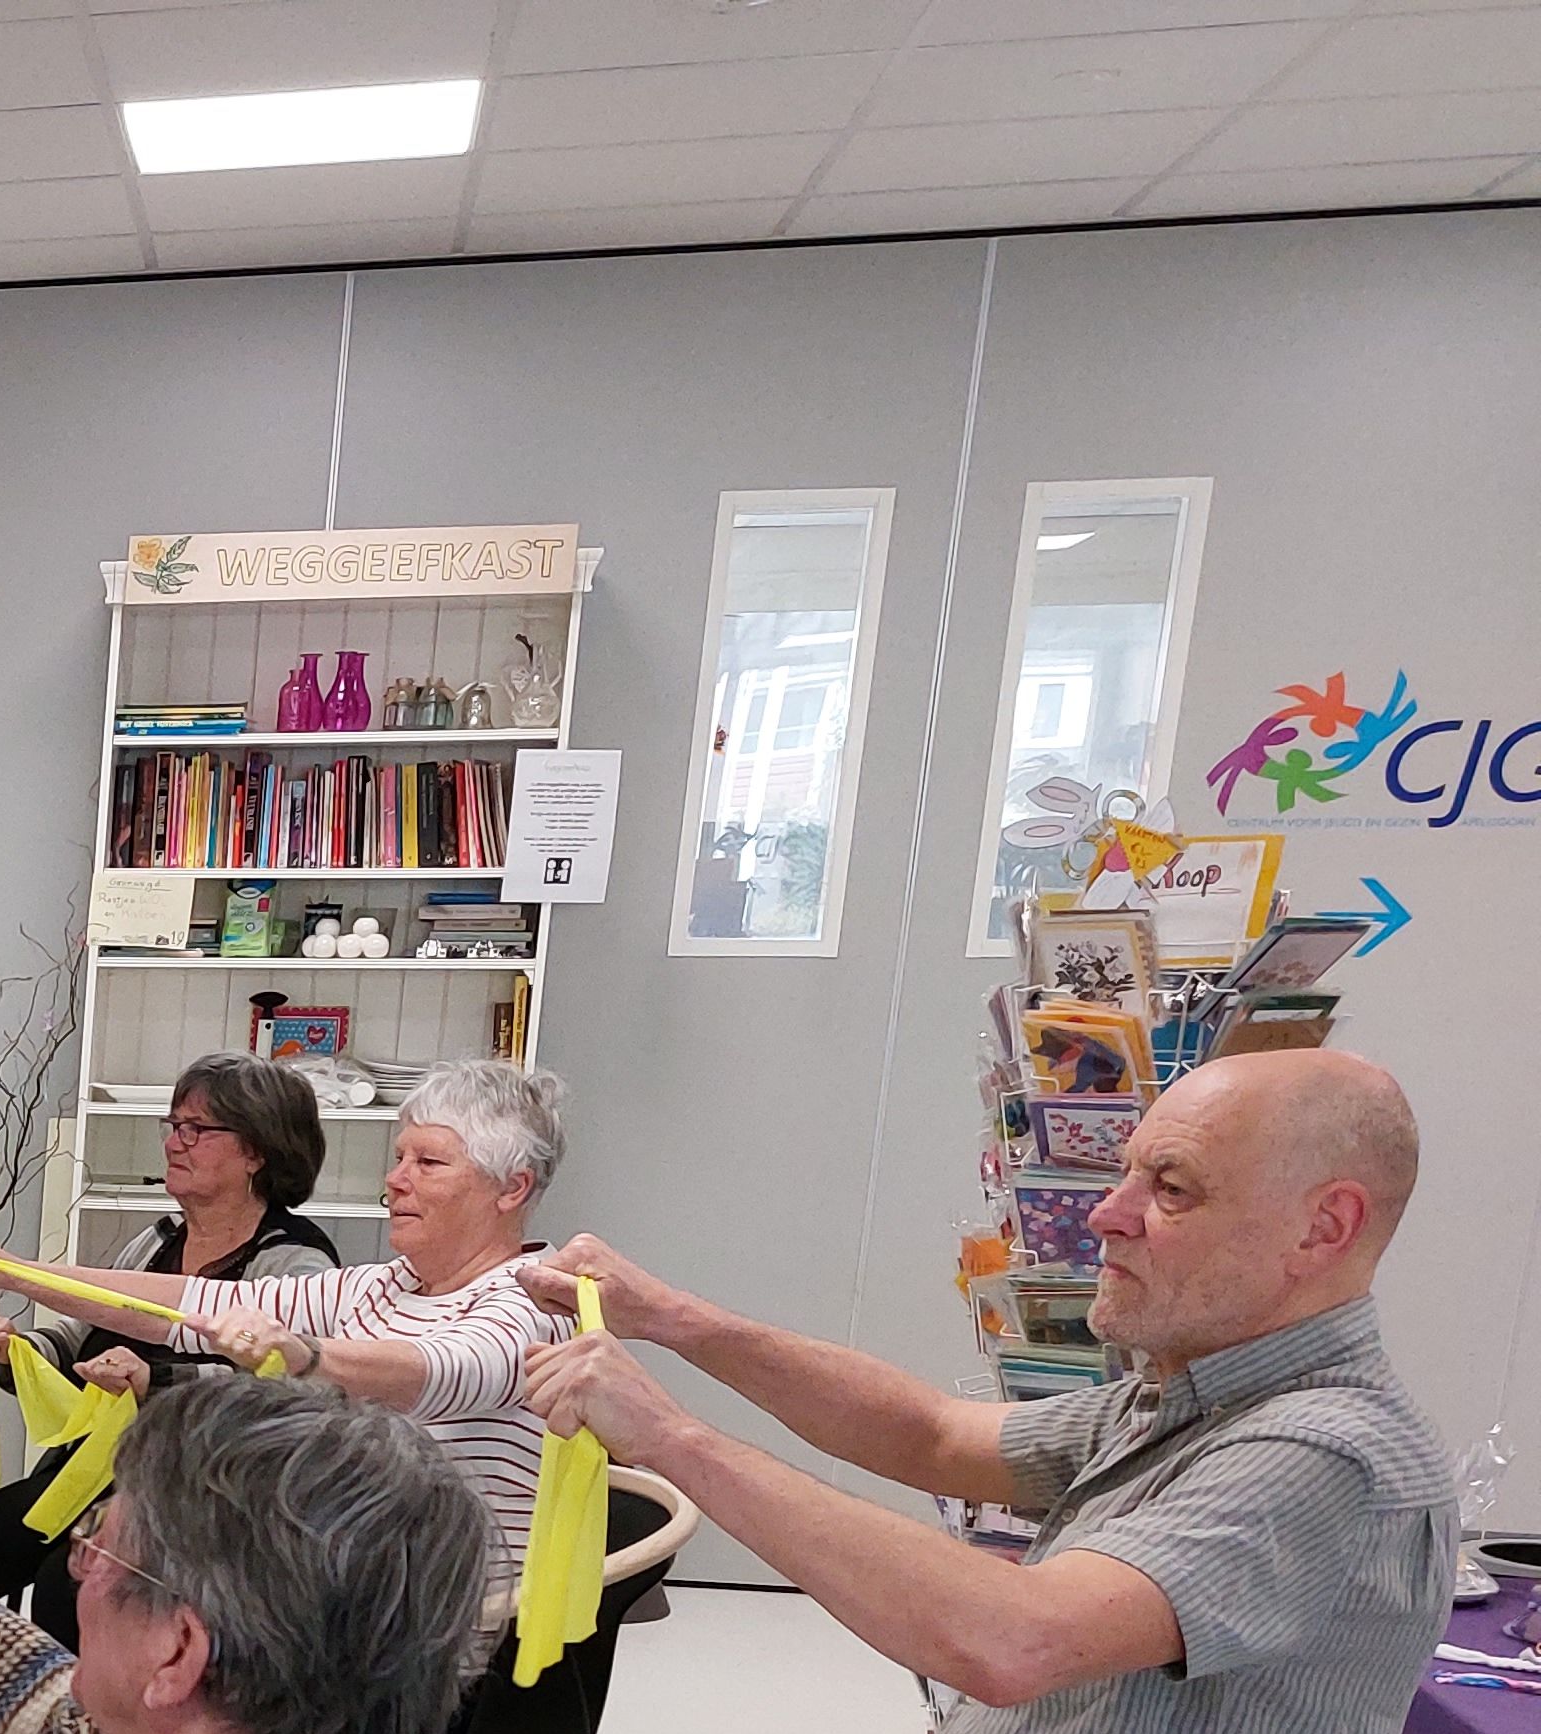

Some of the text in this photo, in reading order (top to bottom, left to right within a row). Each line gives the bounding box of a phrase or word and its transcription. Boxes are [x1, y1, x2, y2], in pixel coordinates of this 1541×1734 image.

[216, 539, 564, 587] WEGGEEFKAST
[1385, 719, 1541, 828] CJG
[171, 930, 185, 946] 19
